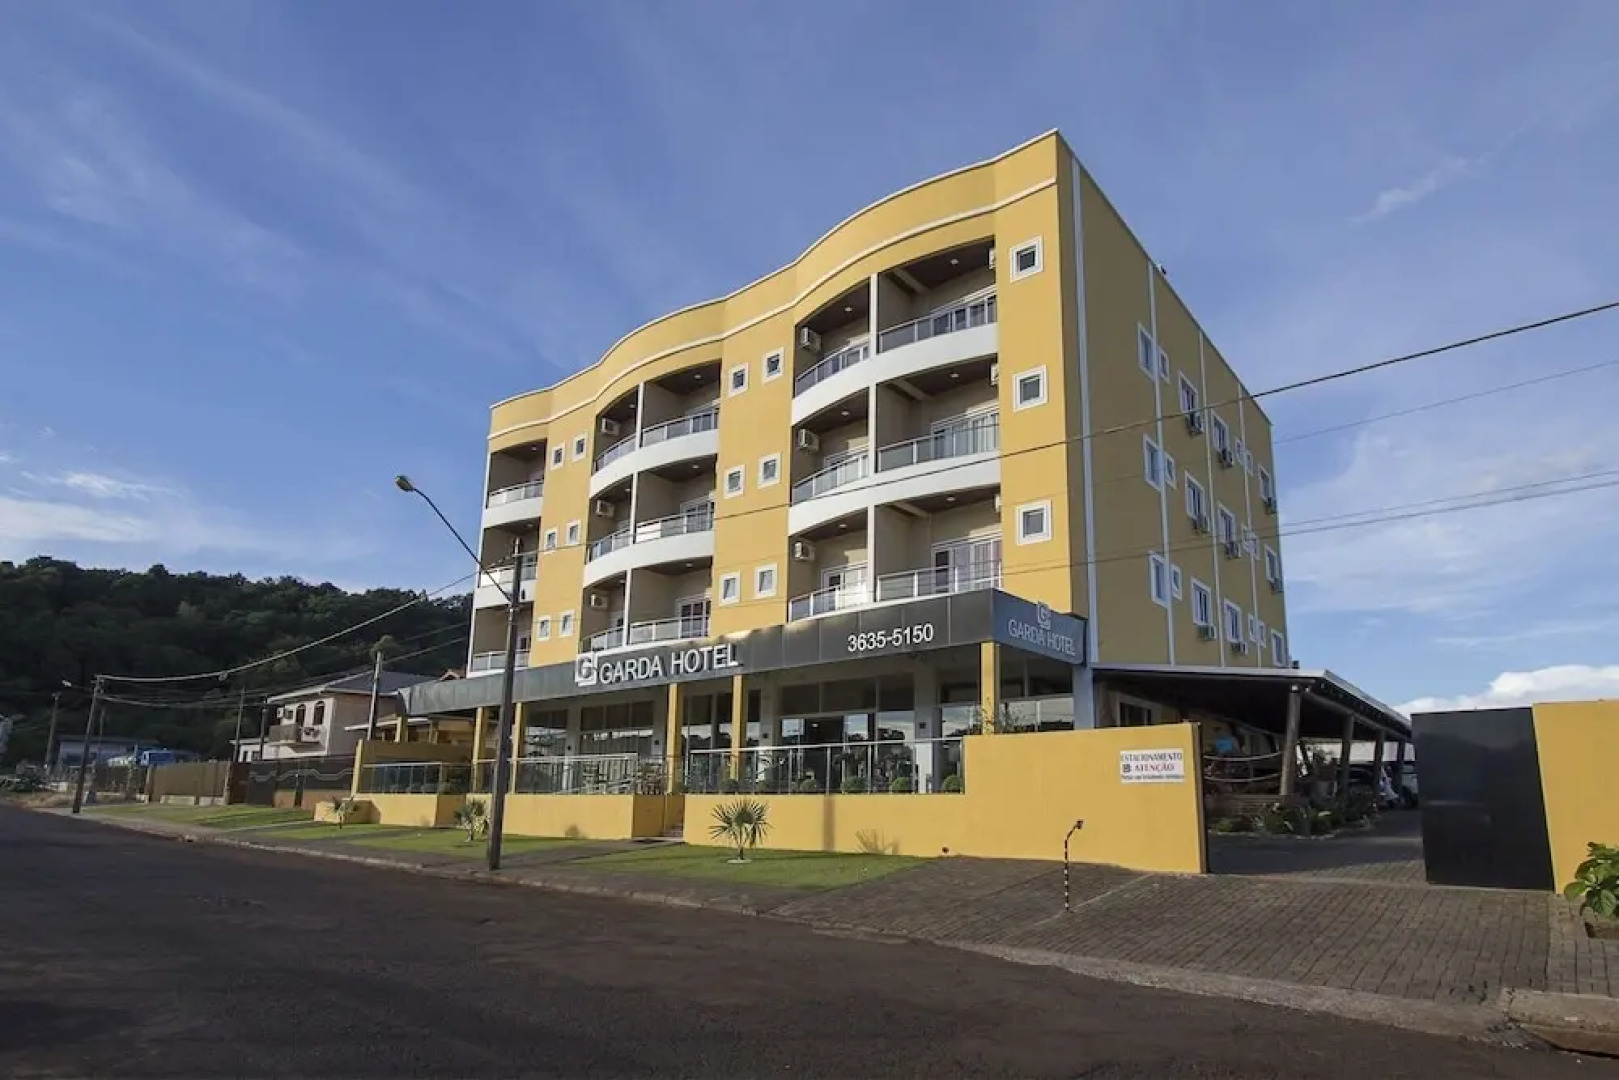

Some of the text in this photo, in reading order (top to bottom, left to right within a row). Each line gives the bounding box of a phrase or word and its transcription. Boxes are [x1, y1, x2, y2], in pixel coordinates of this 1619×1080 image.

[847, 623, 934, 652] 3635-5150
[1008, 619, 1076, 656] GARDA HOTEL
[600, 655, 663, 684] GARDA
[671, 643, 739, 675] HOTEL
[1120, 752, 1183, 762] ESTACIONAMENTO
[1134, 763, 1175, 773] ATENÇÃO
